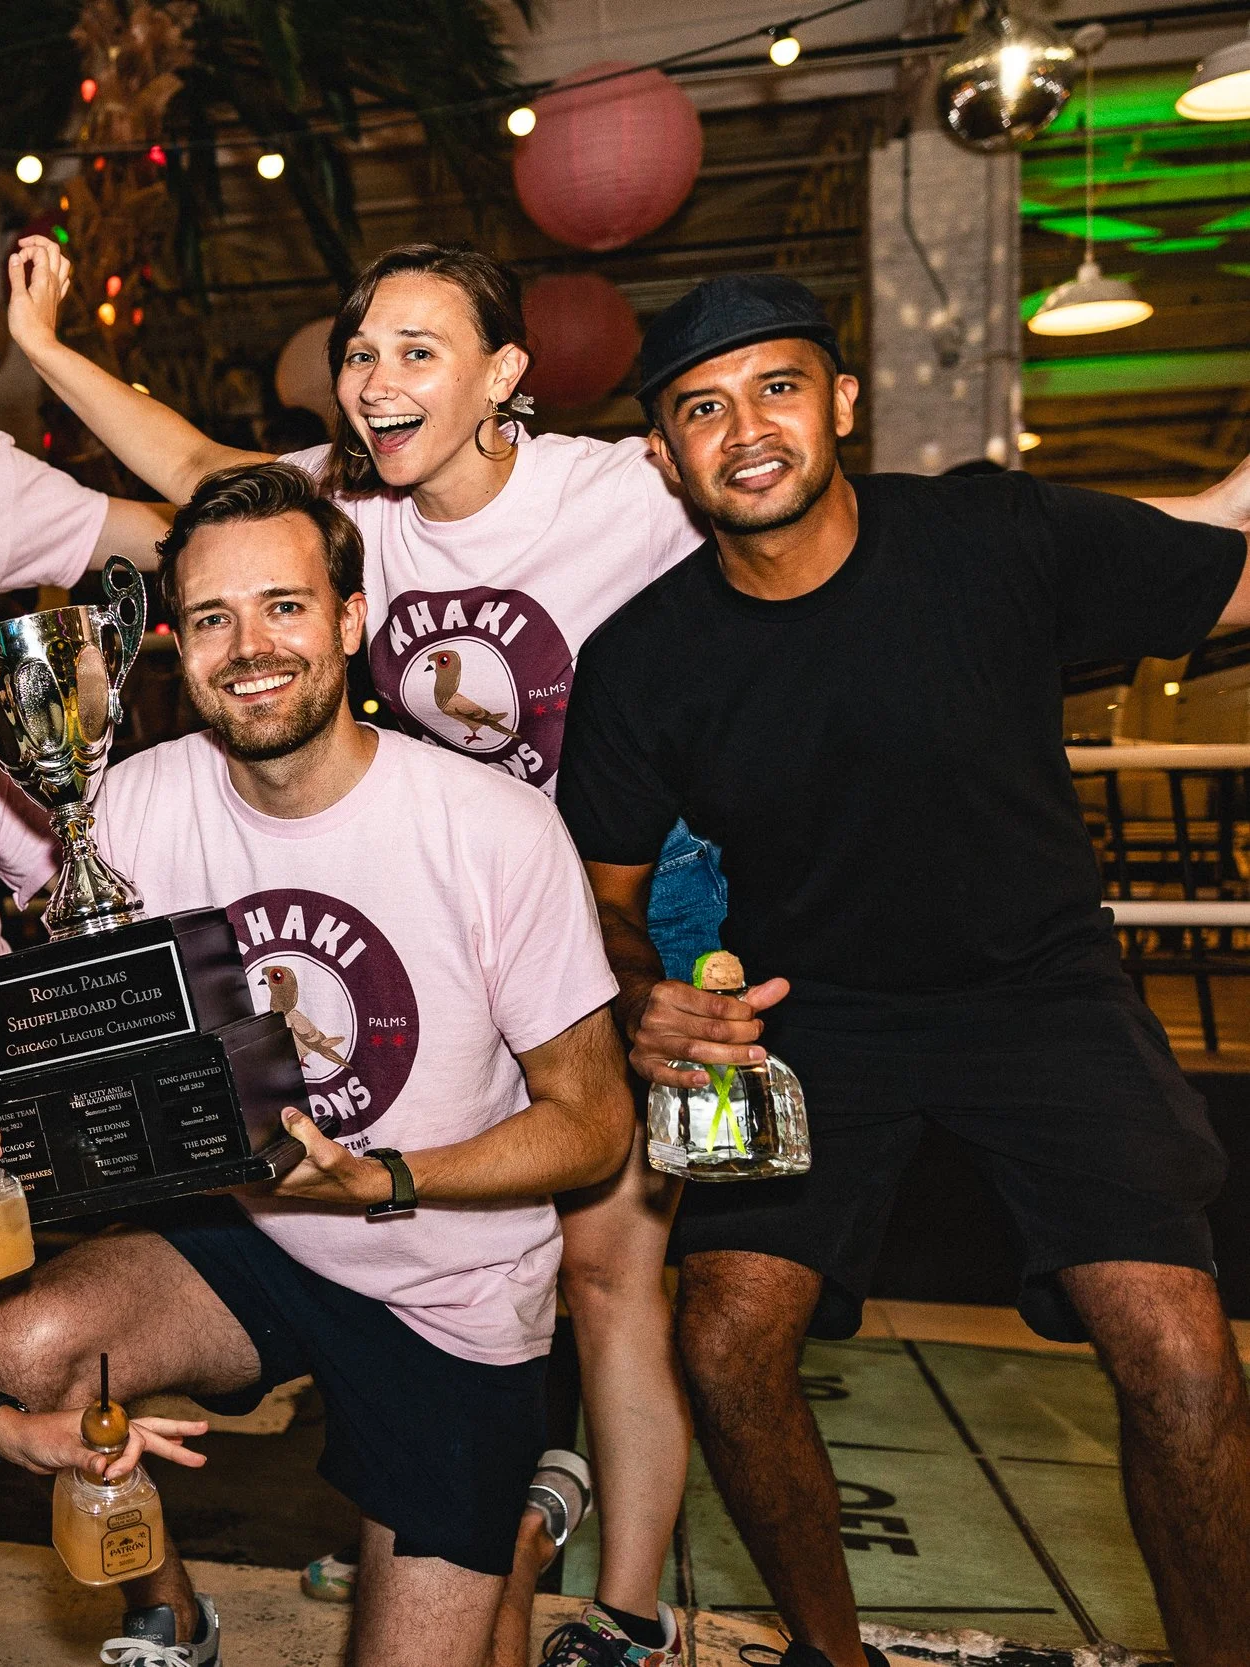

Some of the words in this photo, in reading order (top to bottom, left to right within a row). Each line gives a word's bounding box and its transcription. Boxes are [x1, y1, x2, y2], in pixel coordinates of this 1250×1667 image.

[389, 600, 528, 656] KHAKI
[529, 682, 567, 700] PALMS
[238, 905, 367, 969] HAKI
[368, 1017, 407, 1028] PALMS
[157, 1075, 179, 1086] TANG
[179, 1066, 222, 1081] AFFILIATED
[73, 1092, 88, 1102] RAT
[88, 1088, 107, 1099] CITY
[107, 1085, 124, 1095] AND
[179, 1084, 190, 1092] Fall
[70, 1100, 86, 1109] THE
[86, 1090, 133, 1105] RAZORWIRES
[15, 1108, 37, 1118] TEAM
[84, 1107, 107, 1117] Summer
[192, 1105, 203, 1114] D2
[87, 1126, 103, 1135] THE
[103, 1120, 131, 1131] DONKS
[180, 1117, 204, 1127] Summer
[25, 1140, 36, 1149] SC
[95, 1135, 114, 1145] Spring
[182, 1141, 200, 1150] THE
[200, 1134, 228, 1147] DONKS
[94, 1158, 112, 1168] THE
[112, 1153, 139, 1165] DONKS
[190, 1150, 210, 1160] Spring
